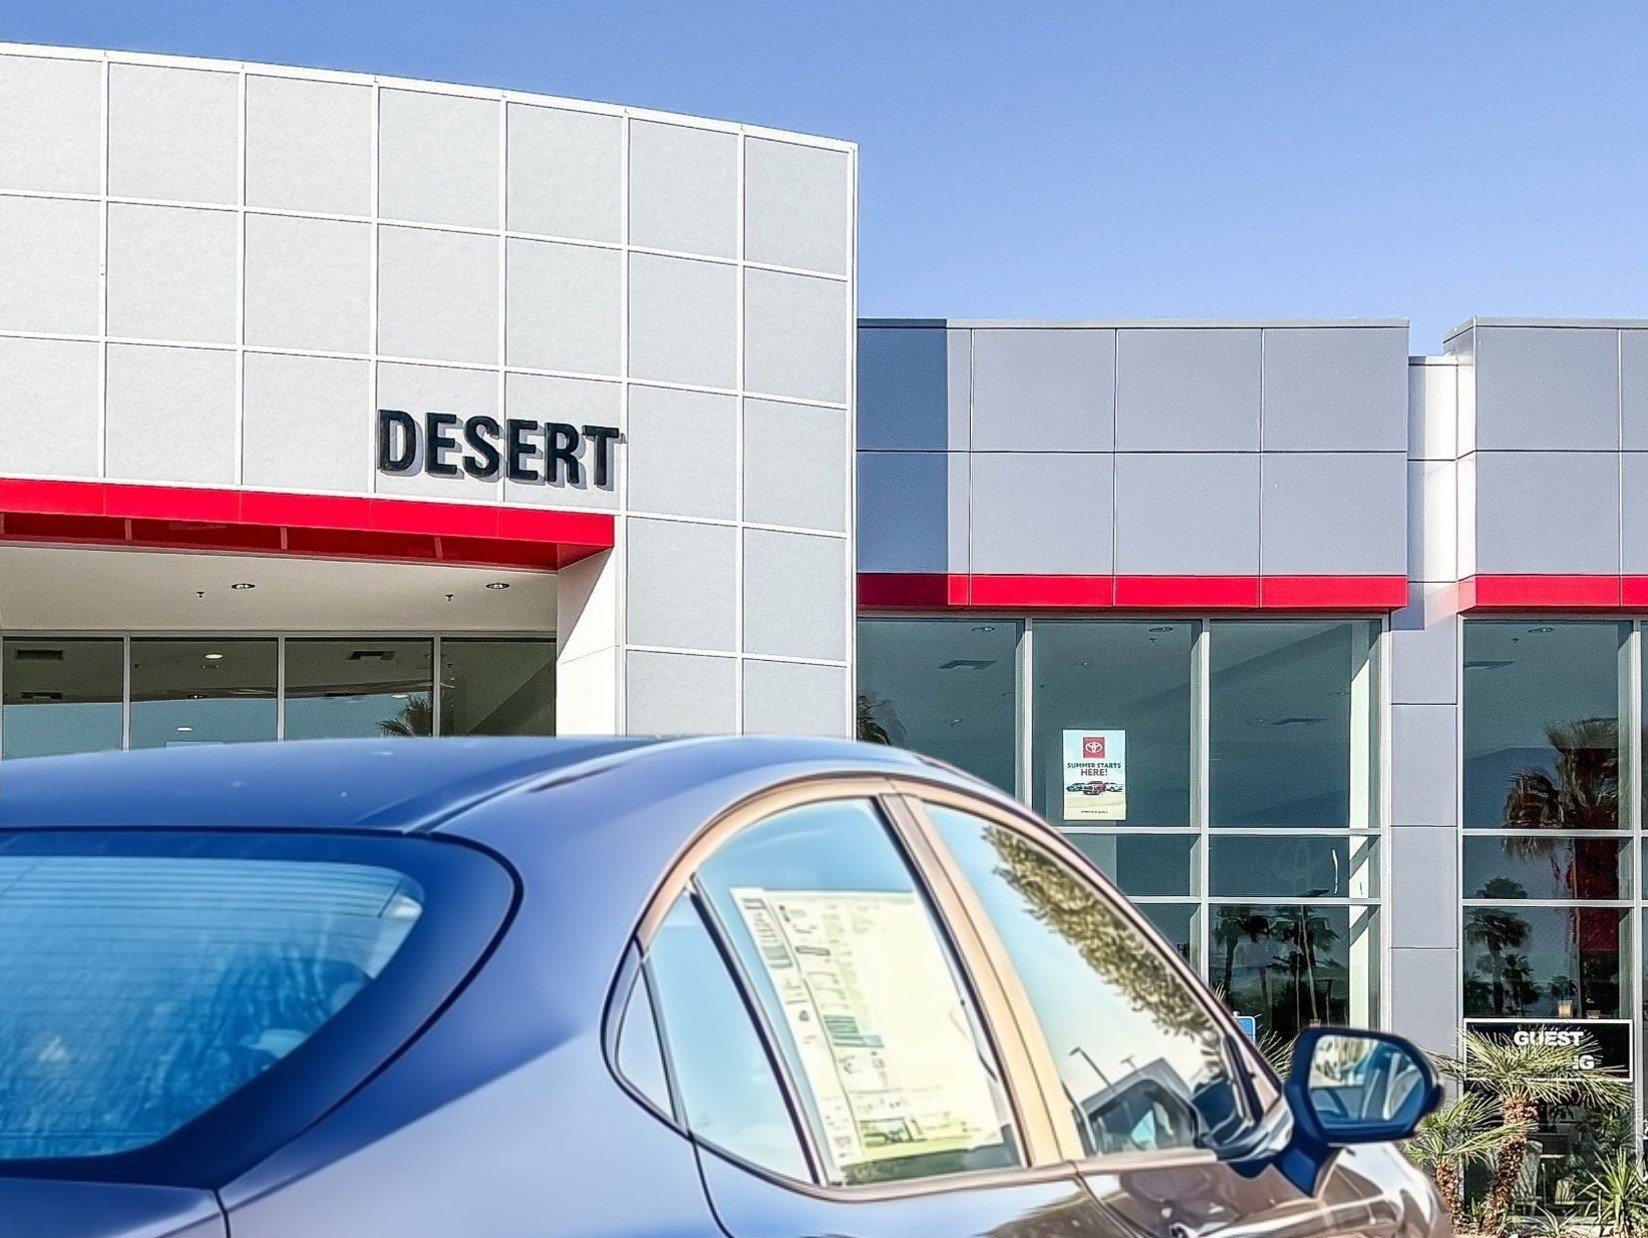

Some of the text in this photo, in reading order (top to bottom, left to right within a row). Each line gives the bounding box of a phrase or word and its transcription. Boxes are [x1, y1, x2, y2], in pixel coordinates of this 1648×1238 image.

[377, 409, 621, 487] DESERT
[1080, 768, 1108, 776] HERE!
[1513, 1030, 1584, 1047] GUEST
